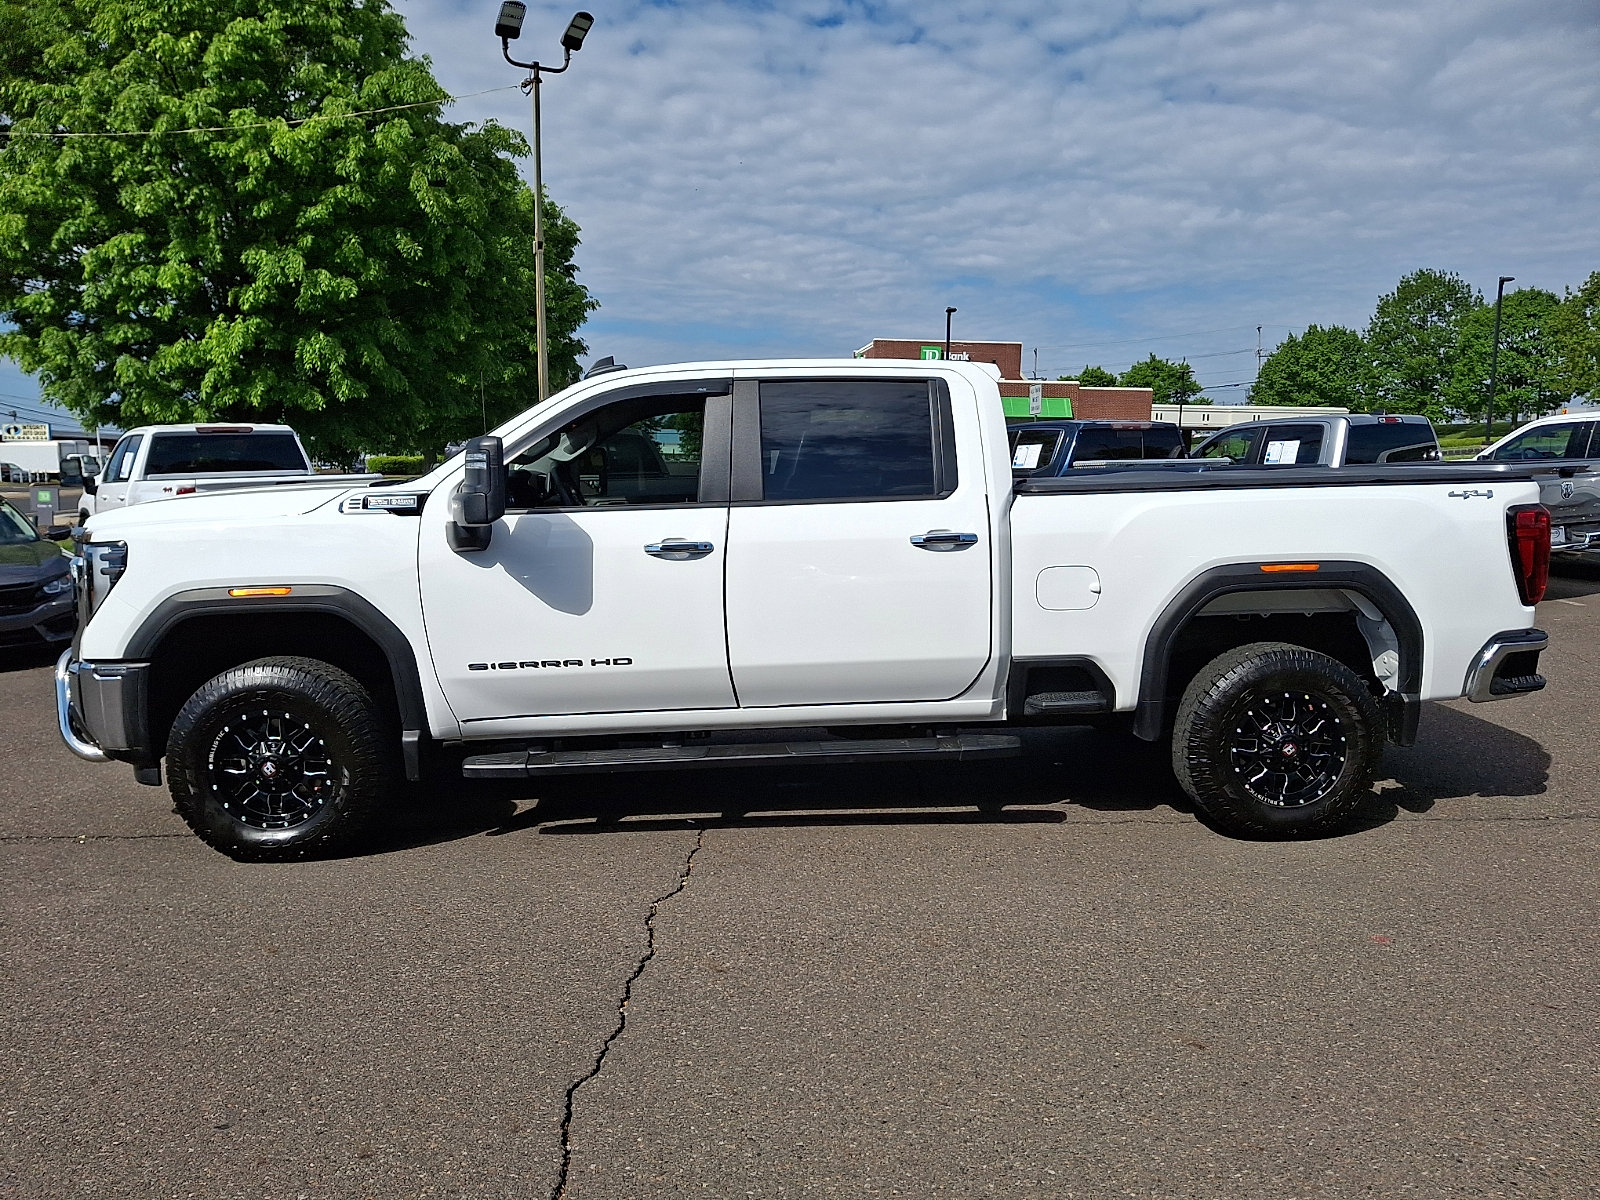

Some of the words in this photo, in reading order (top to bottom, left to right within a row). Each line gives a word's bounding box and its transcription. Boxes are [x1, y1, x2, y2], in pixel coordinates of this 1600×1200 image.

[922, 348, 940, 360] TD
[468, 659, 584, 671] SIERRA
[590, 657, 633, 667] HD
[208, 730, 226, 763] BALLISTIC
